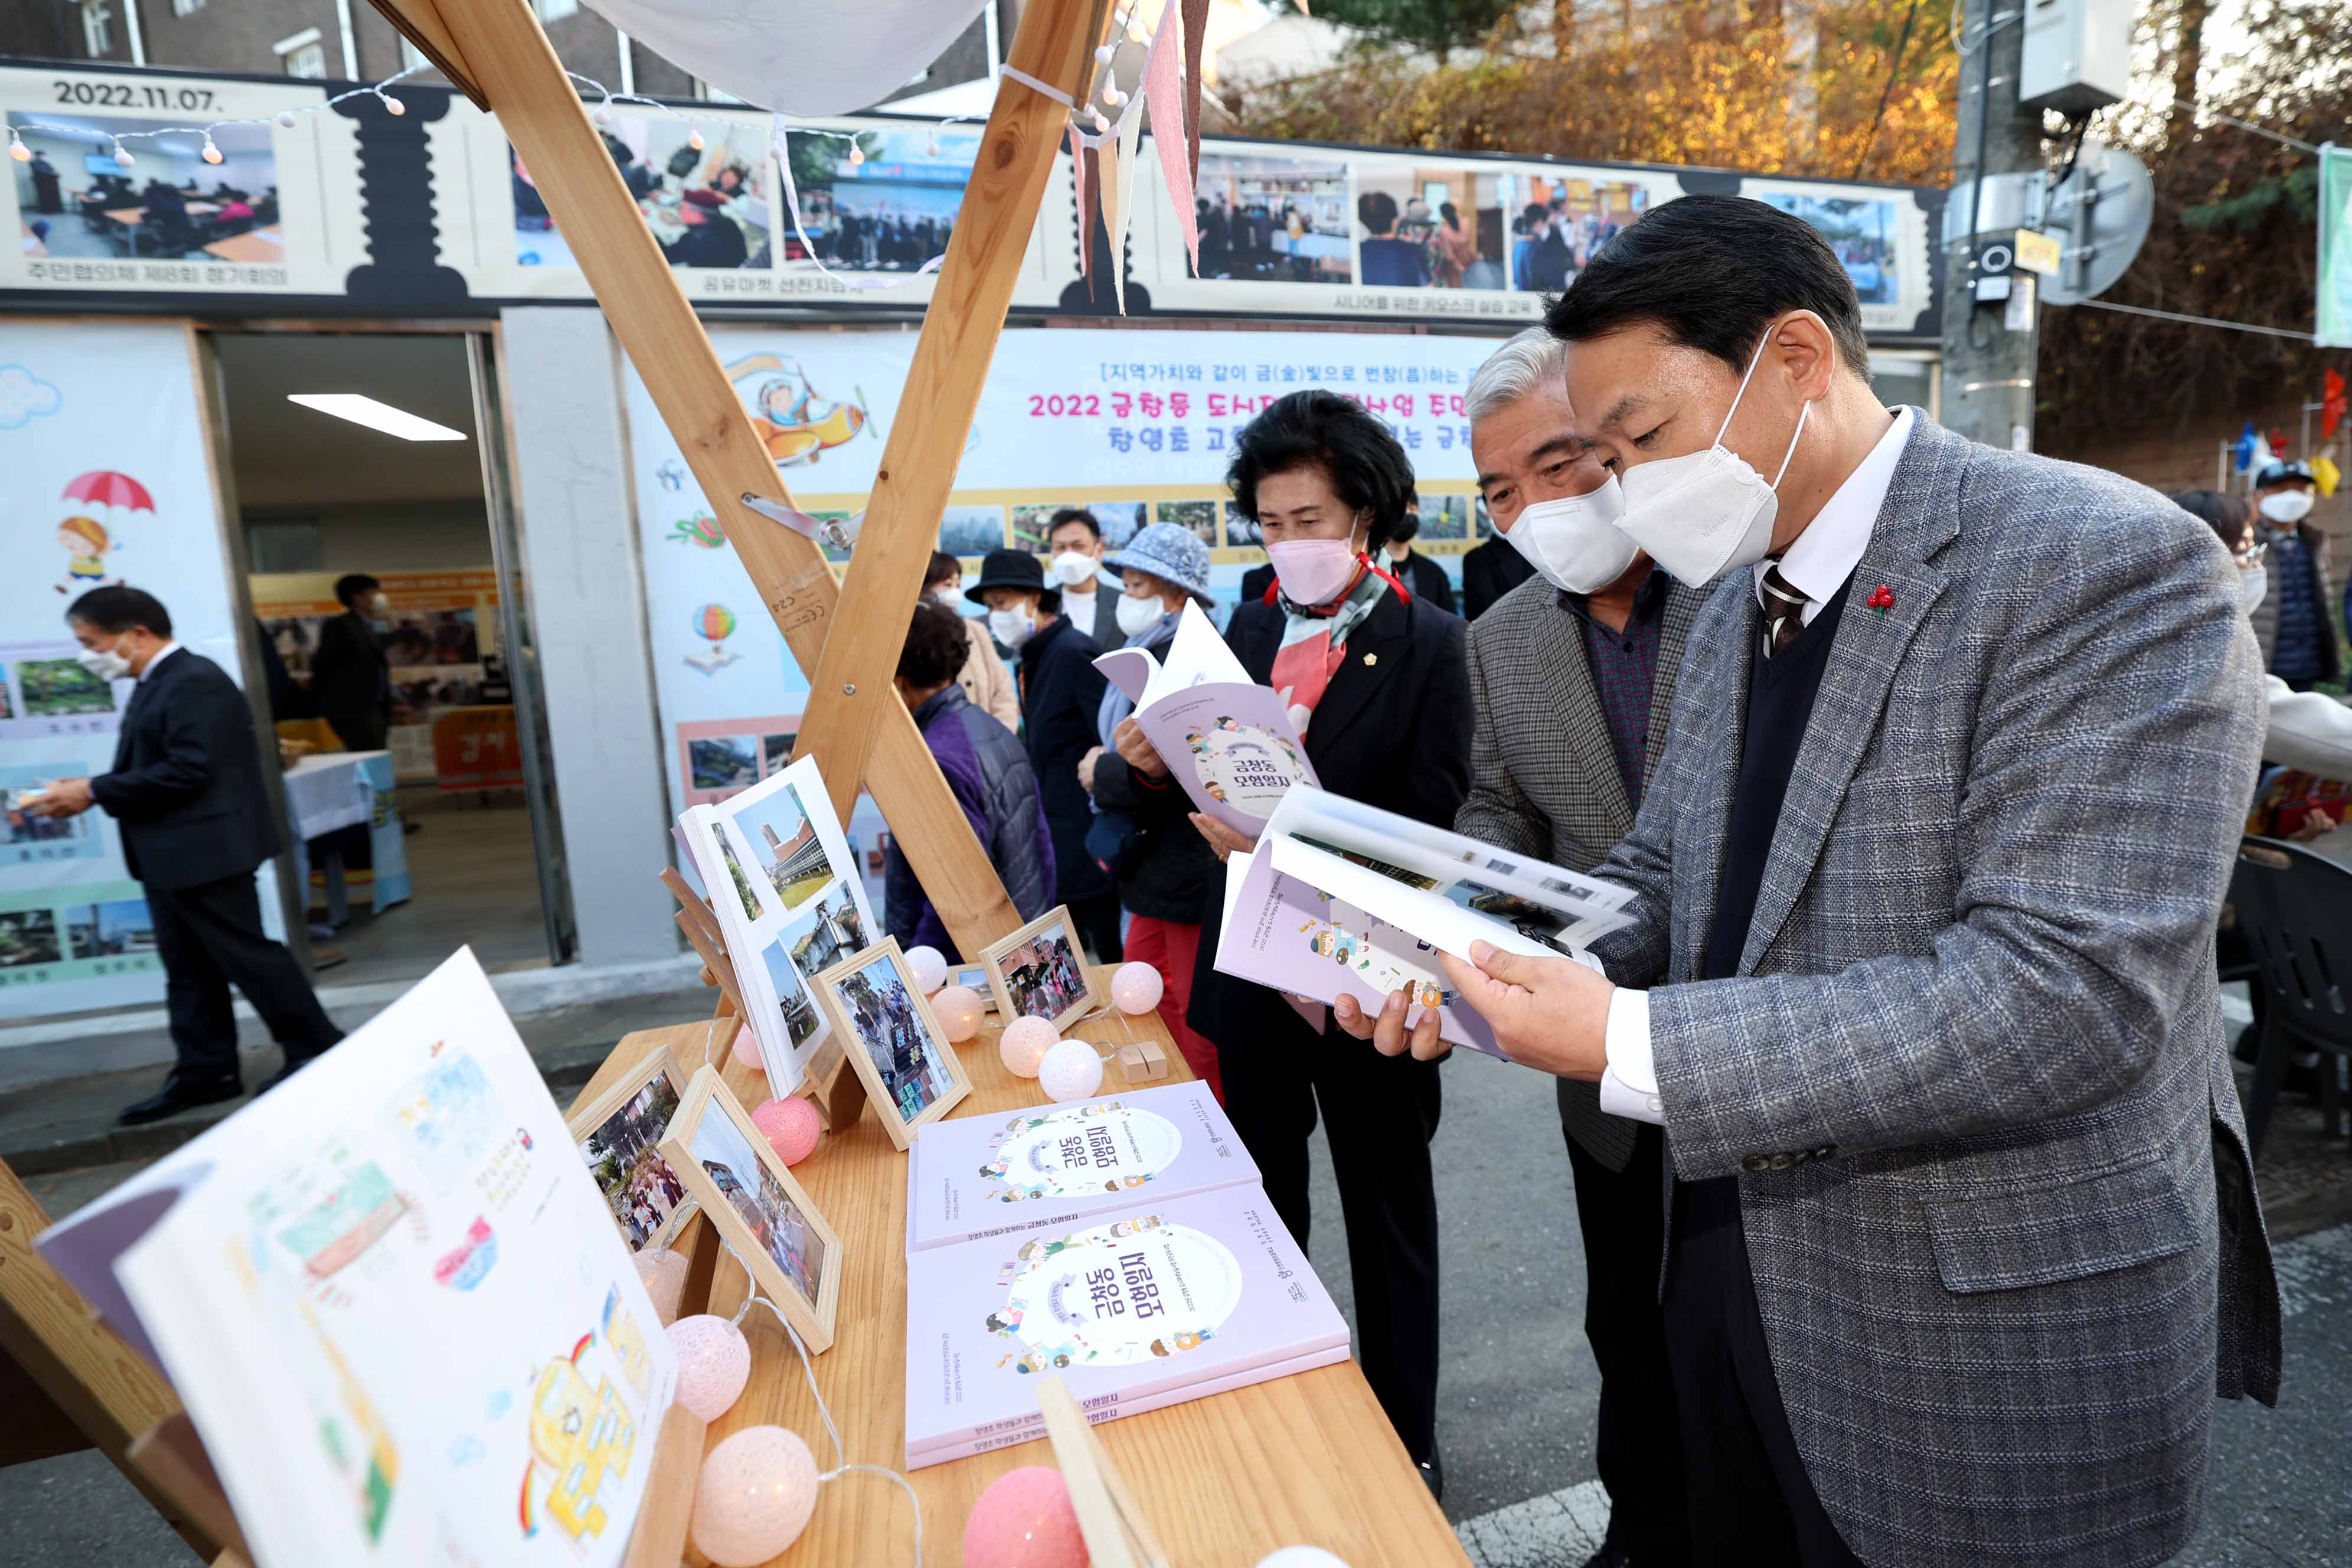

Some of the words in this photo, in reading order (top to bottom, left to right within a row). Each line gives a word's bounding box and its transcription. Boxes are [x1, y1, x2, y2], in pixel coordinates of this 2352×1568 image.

[54, 81, 225, 113] 2022.11.07.
[1212, 364, 1246, 383] 같이
[1028, 394, 1100, 416] 2022
[1110, 392, 1191, 418] 금창동
[1108, 426, 1190, 453] 창영초
[1233, 760, 1277, 772] 금창동
[1233, 775, 1291, 788] 모험일지
[1059, 1136, 1087, 1169] 금창동
[1086, 1126, 1118, 1168] 모험일지
[1050, 1213, 1079, 1224] 모험일지
[1086, 1268, 1125, 1319] 금창동
[1119, 1252, 1165, 1319] 모험일지
[1083, 1393, 1118, 1409] 모험일지
[1087, 1409, 1118, 1423] 험일지
